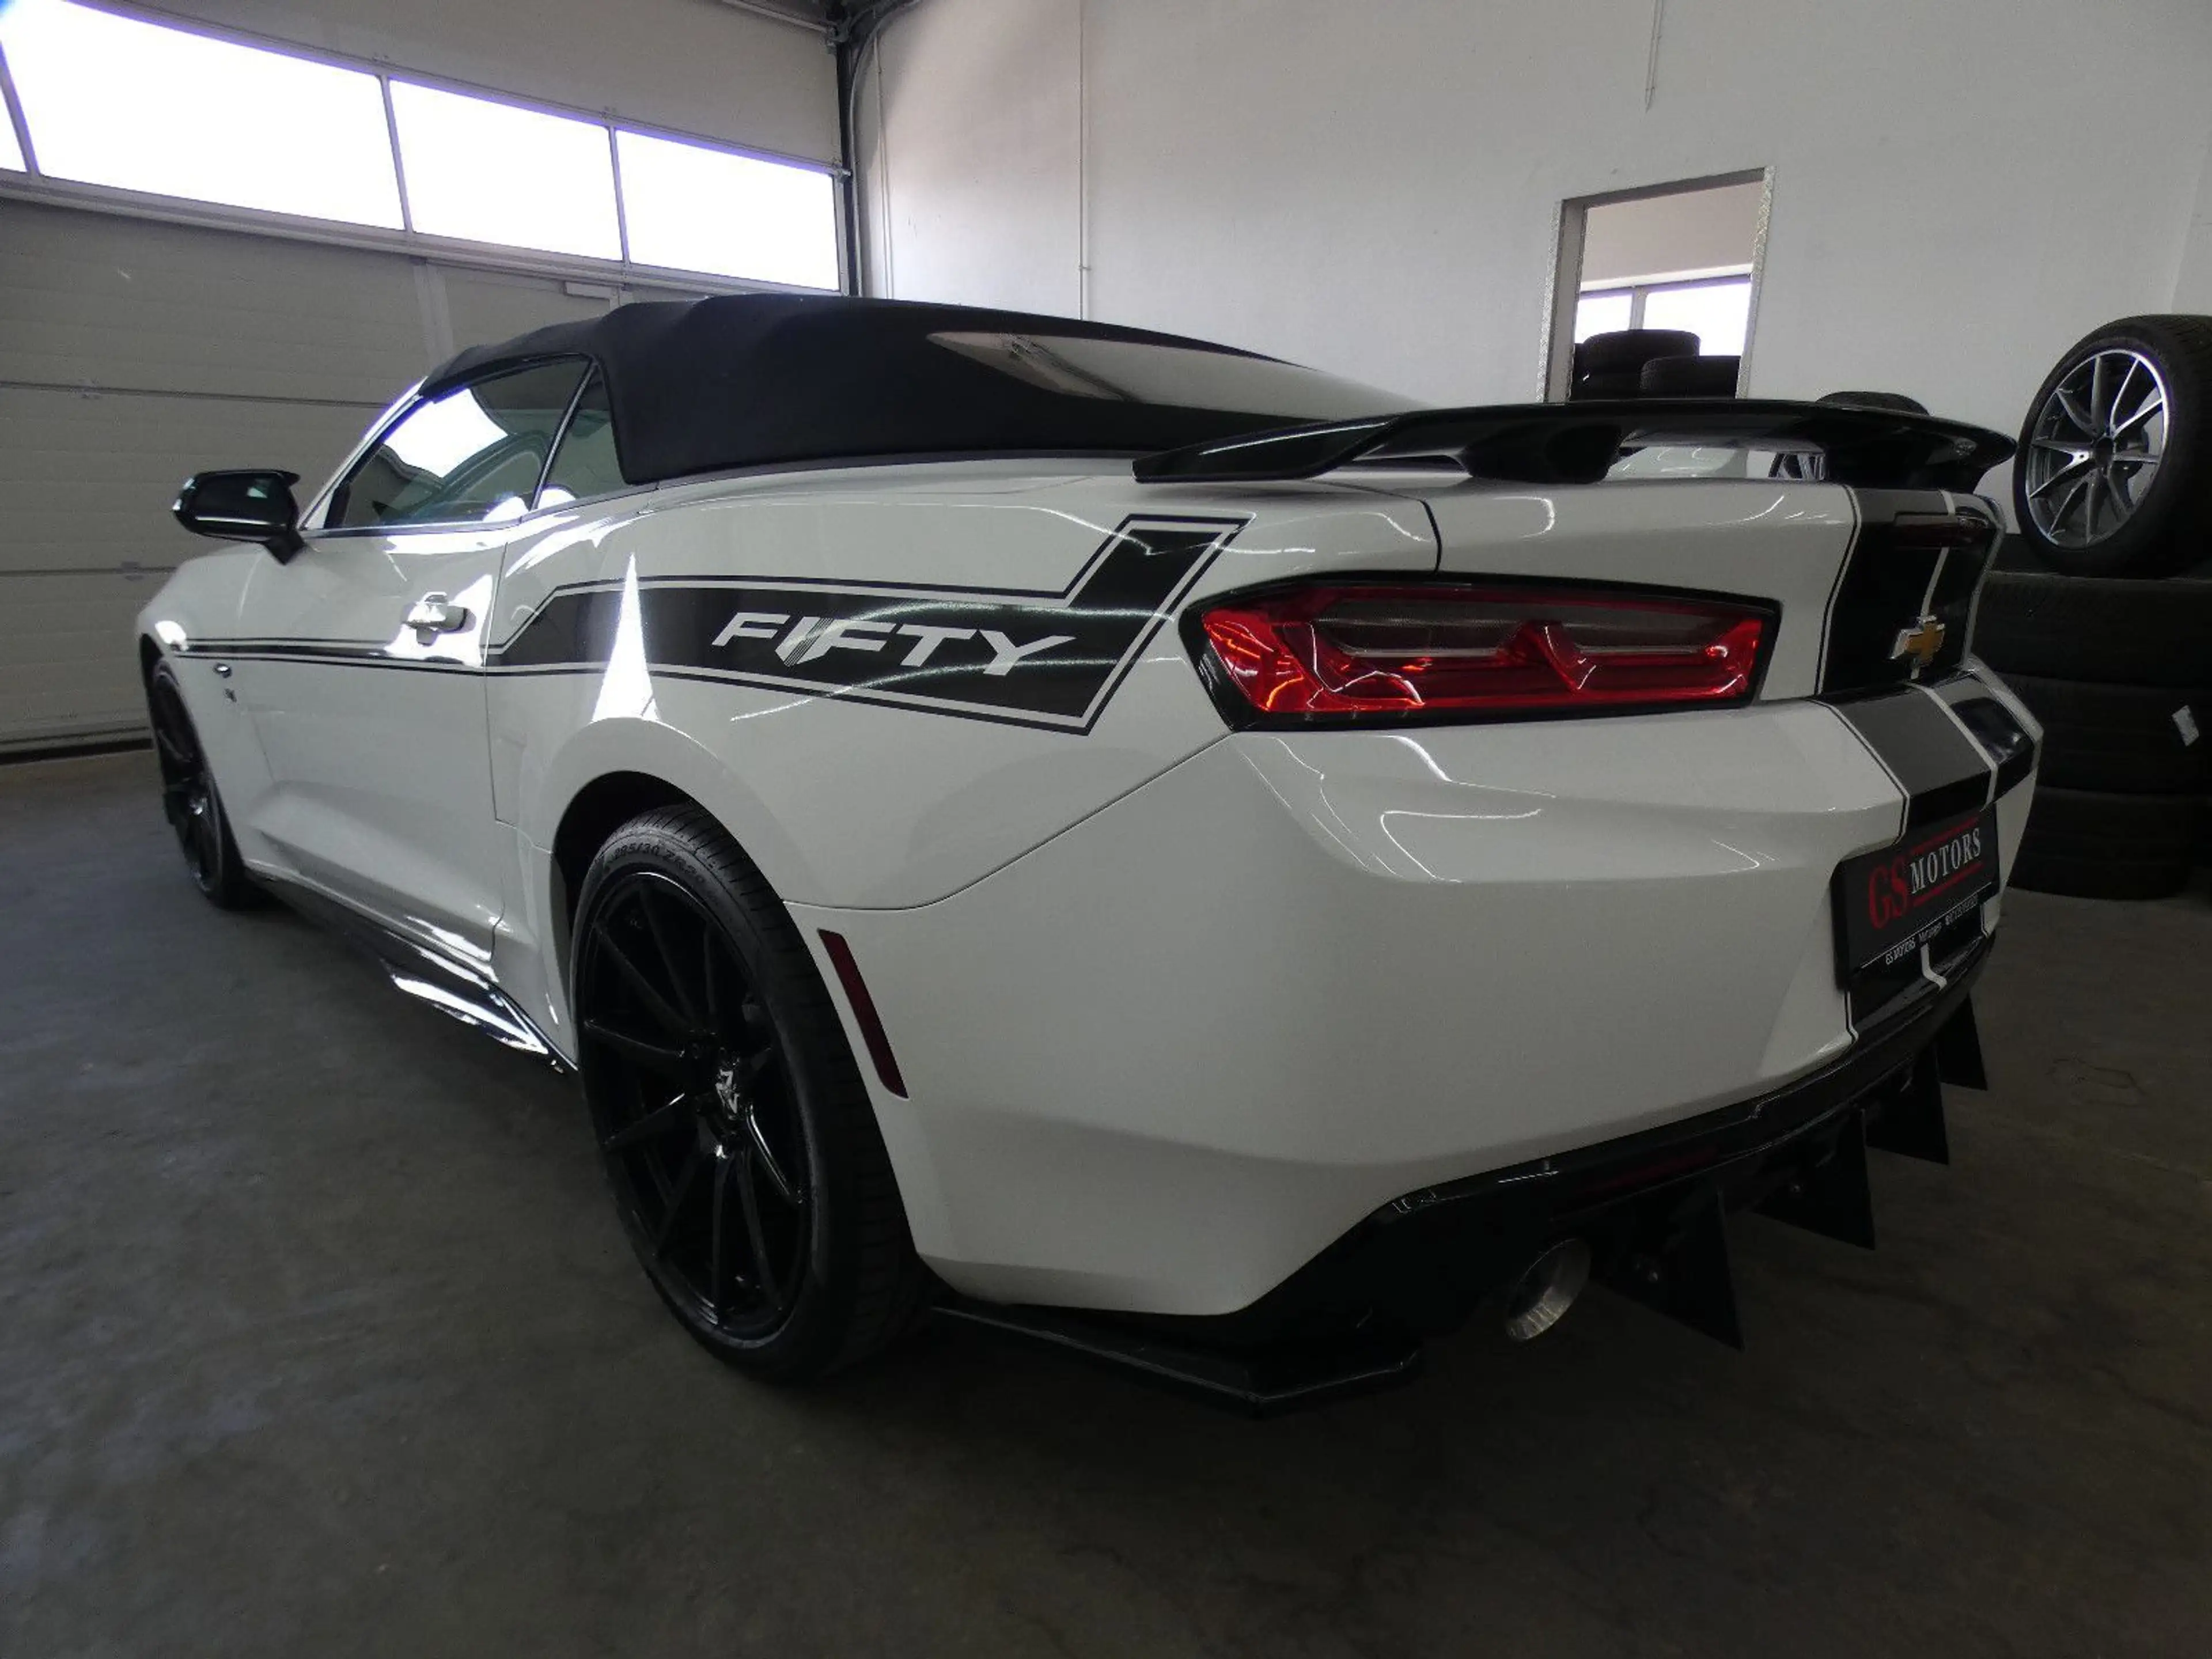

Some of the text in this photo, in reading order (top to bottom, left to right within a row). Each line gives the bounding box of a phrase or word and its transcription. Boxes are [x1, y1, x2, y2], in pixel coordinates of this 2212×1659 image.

[711, 612, 1076, 676] FIFTY
[1868, 856, 1908, 929] GS
[1910, 828, 1981, 894] MOTORS
